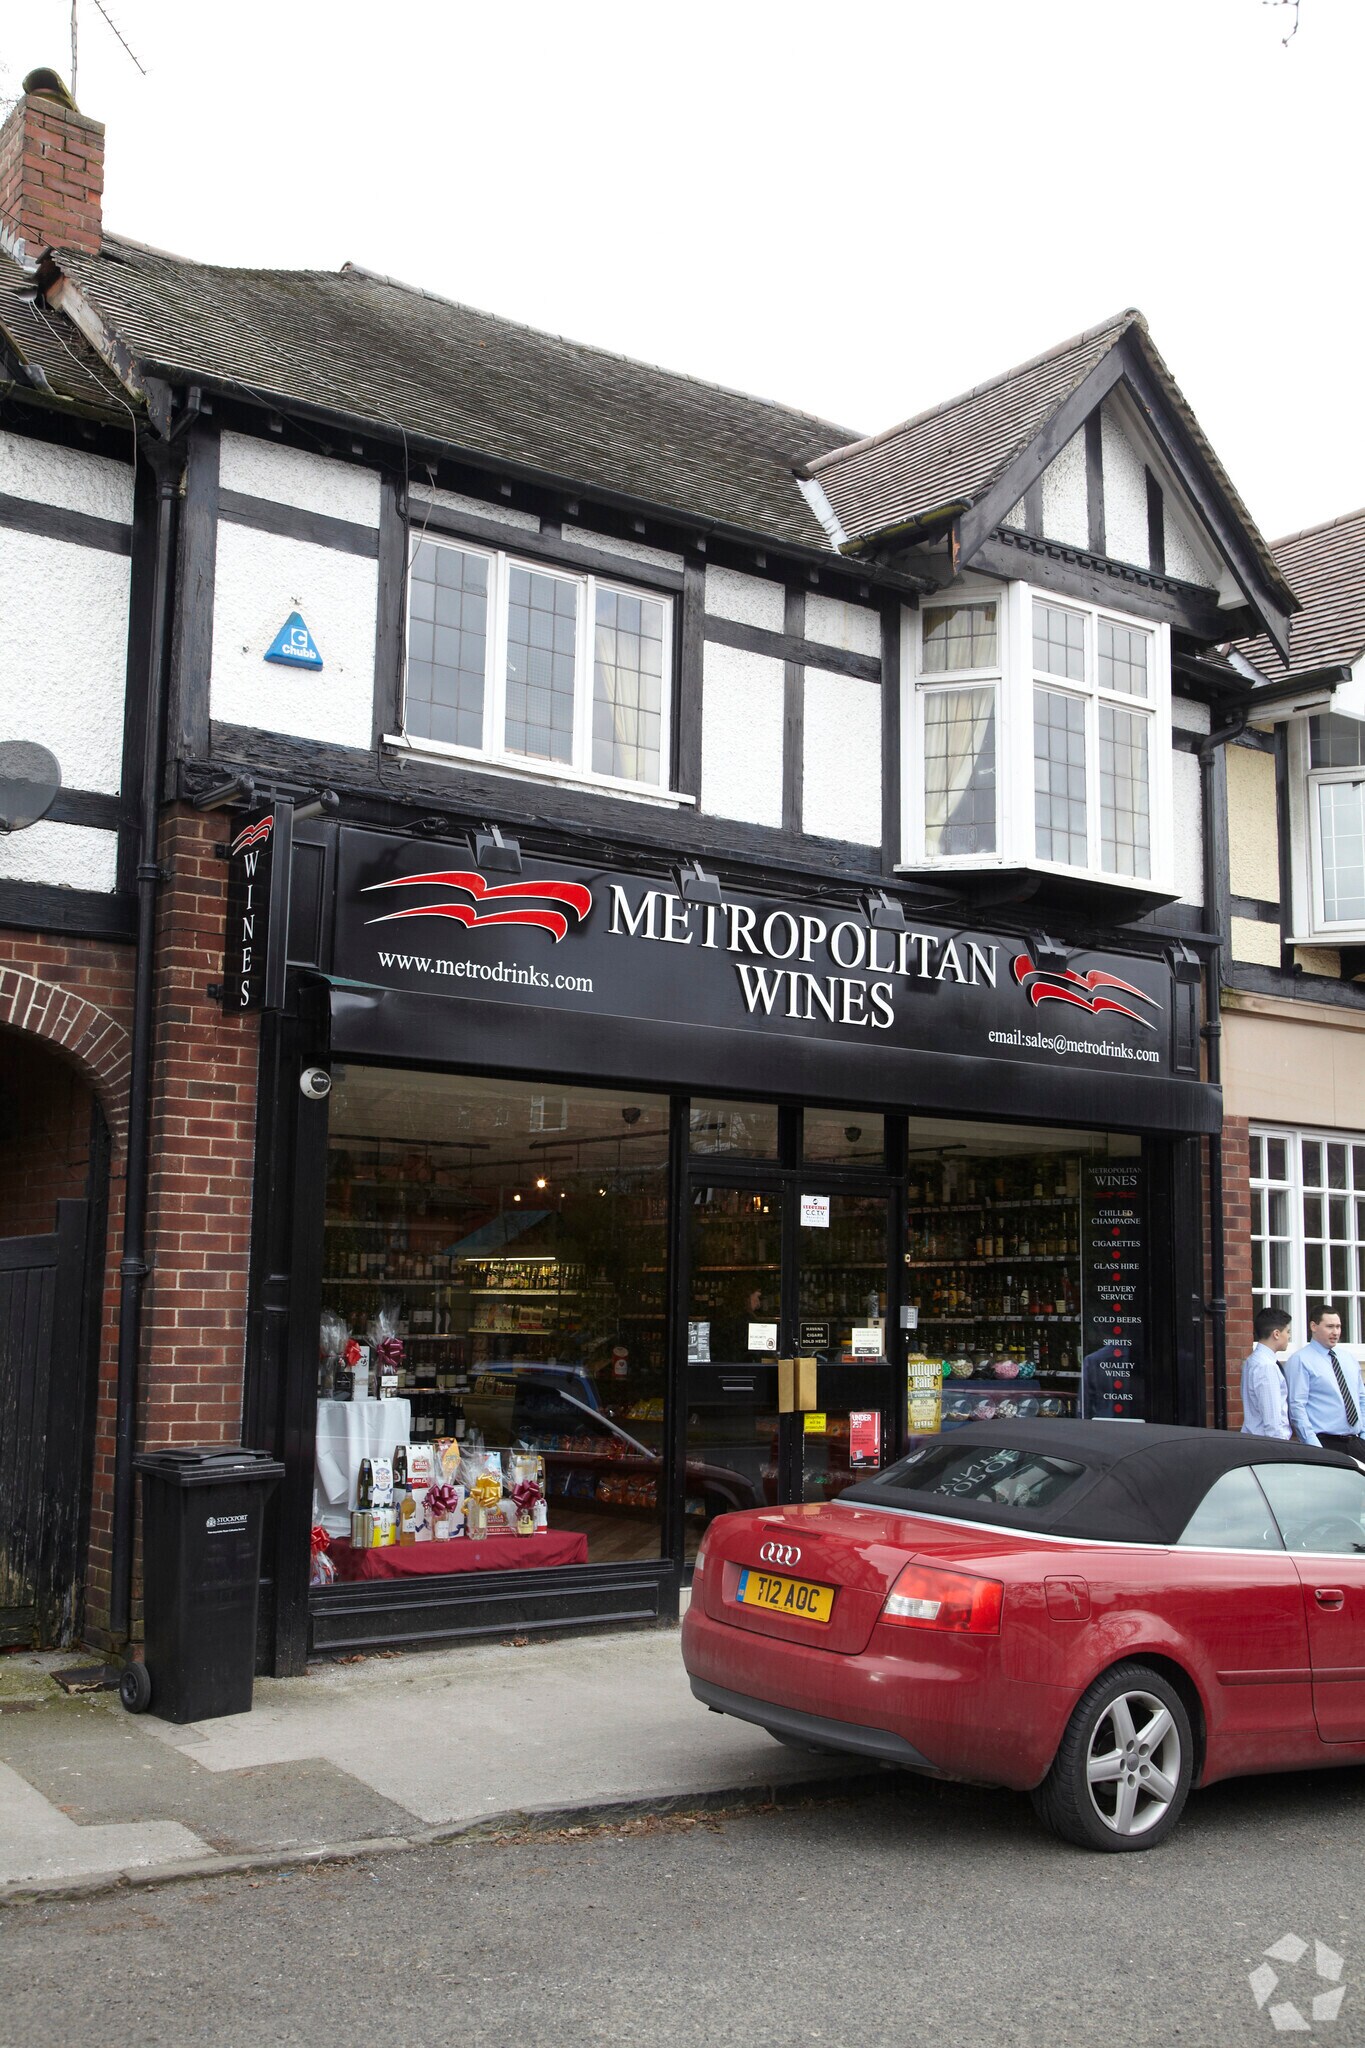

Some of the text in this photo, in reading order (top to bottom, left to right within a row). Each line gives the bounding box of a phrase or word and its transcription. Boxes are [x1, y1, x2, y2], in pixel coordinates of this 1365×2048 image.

[282, 644, 317, 659] Chubb
[239, 849, 260, 1007] WINES
[607, 884, 1000, 988] METROPOLITAN
[377, 951, 594, 993] www.metrodrinks.com
[735, 963, 896, 1029] WINES
[988, 1029, 1161, 1063] email:sales@metrodrinks.com
[1095, 1175, 1138, 1186] WINES
[1099, 1209, 1133, 1217] CHILLED
[1091, 1217, 1141, 1225] CHAMPAGNE
[1092, 1240, 1141, 1248] CIGARETTES
[1093, 1262, 1119, 1270] GLASS
[1097, 1285, 1137, 1293] DELIVERY
[1100, 1293, 1134, 1301] SERVICE
[1093, 1315, 1142, 1324] COLD BEERS
[1103, 1338, 1132, 1346] SPIRITS
[1099, 1361, 1135, 1370] QUALITY
[1105, 1370, 1131, 1378] WINES
[1103, 1392, 1133, 1400] CIGARS
[852, 1414, 872, 1422] UNDER
[216, 1514, 248, 1523] STOCKPORT
[758, 1577, 782, 1604] T12
